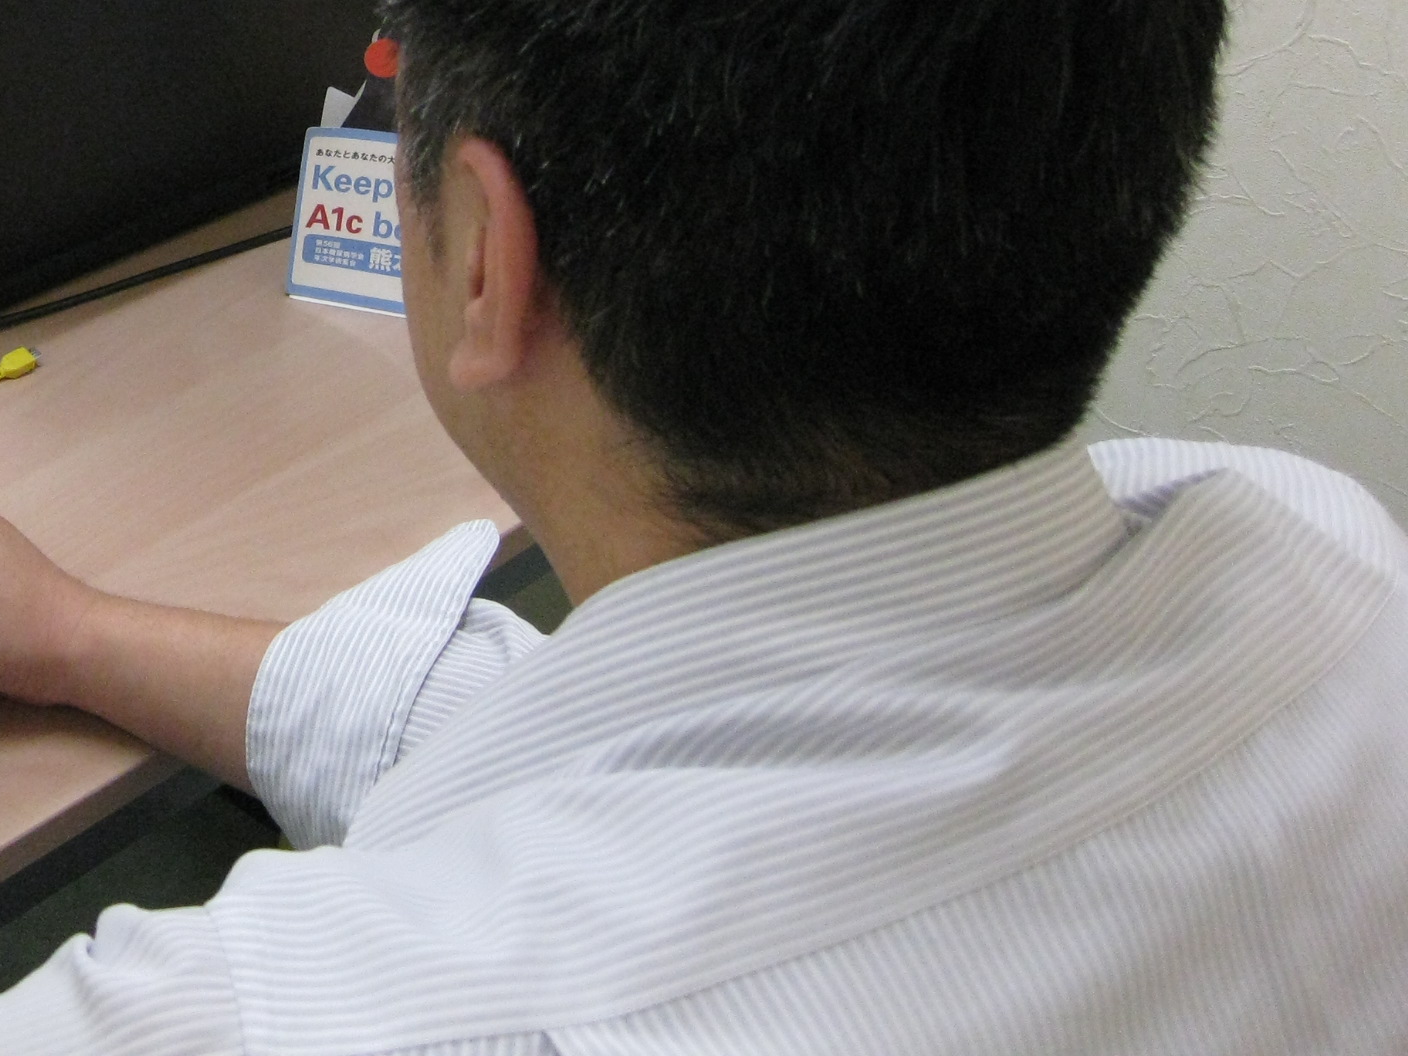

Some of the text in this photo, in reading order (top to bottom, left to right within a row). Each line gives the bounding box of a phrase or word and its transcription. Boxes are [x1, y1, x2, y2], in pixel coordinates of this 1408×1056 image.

[315, 148, 396, 164] あなたとあなたの大
[311, 164, 394, 203] Keep
[305, 203, 364, 234] A1c
[315, 238, 341, 249] 第56回
